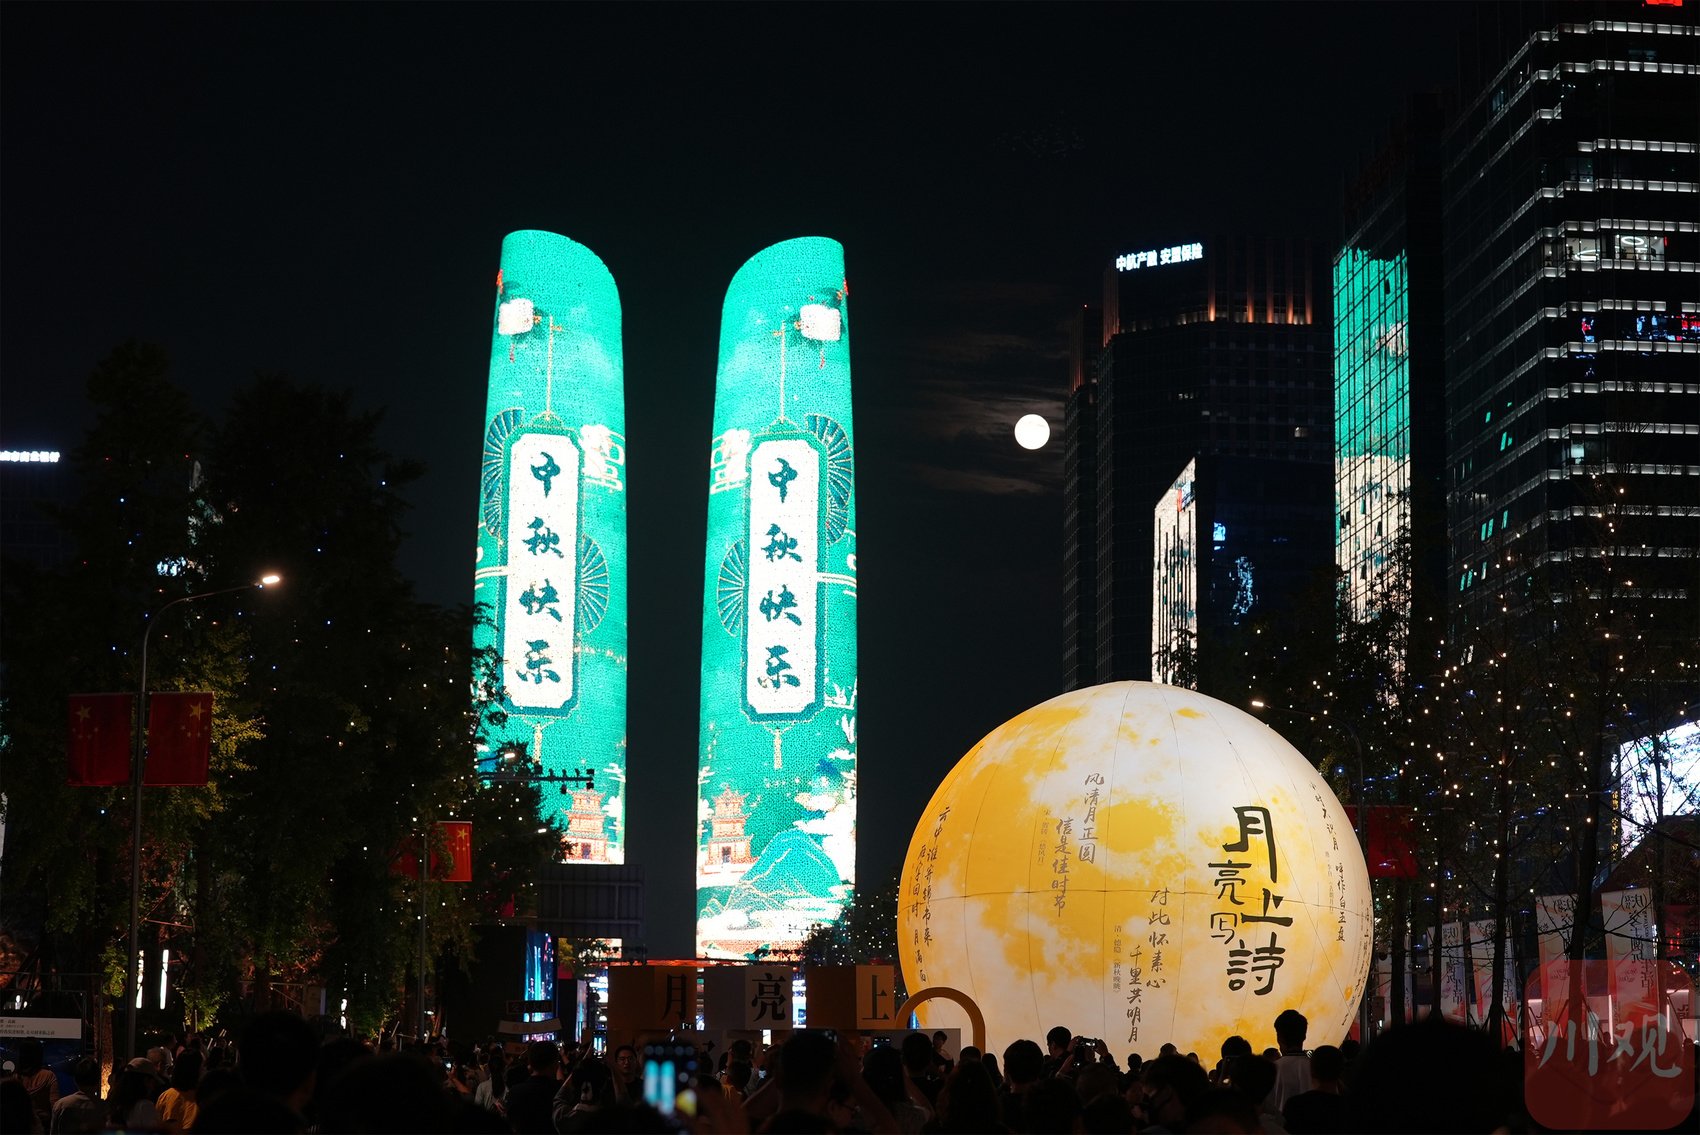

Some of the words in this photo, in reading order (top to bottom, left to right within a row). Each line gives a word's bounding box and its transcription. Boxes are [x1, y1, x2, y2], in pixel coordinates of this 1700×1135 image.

[514, 450, 566, 687] 中秋快乐
[756, 456, 804, 691] 中秋快乐
[1051, 816, 1075, 918] 信是佳时节
[1078, 772, 1105, 865] 风清月正圆
[662, 973, 687, 1020] 月
[751, 972, 786, 1022] 亮
[862, 974, 890, 1020] 上
[1127, 945, 1144, 1044] 千里共明月
